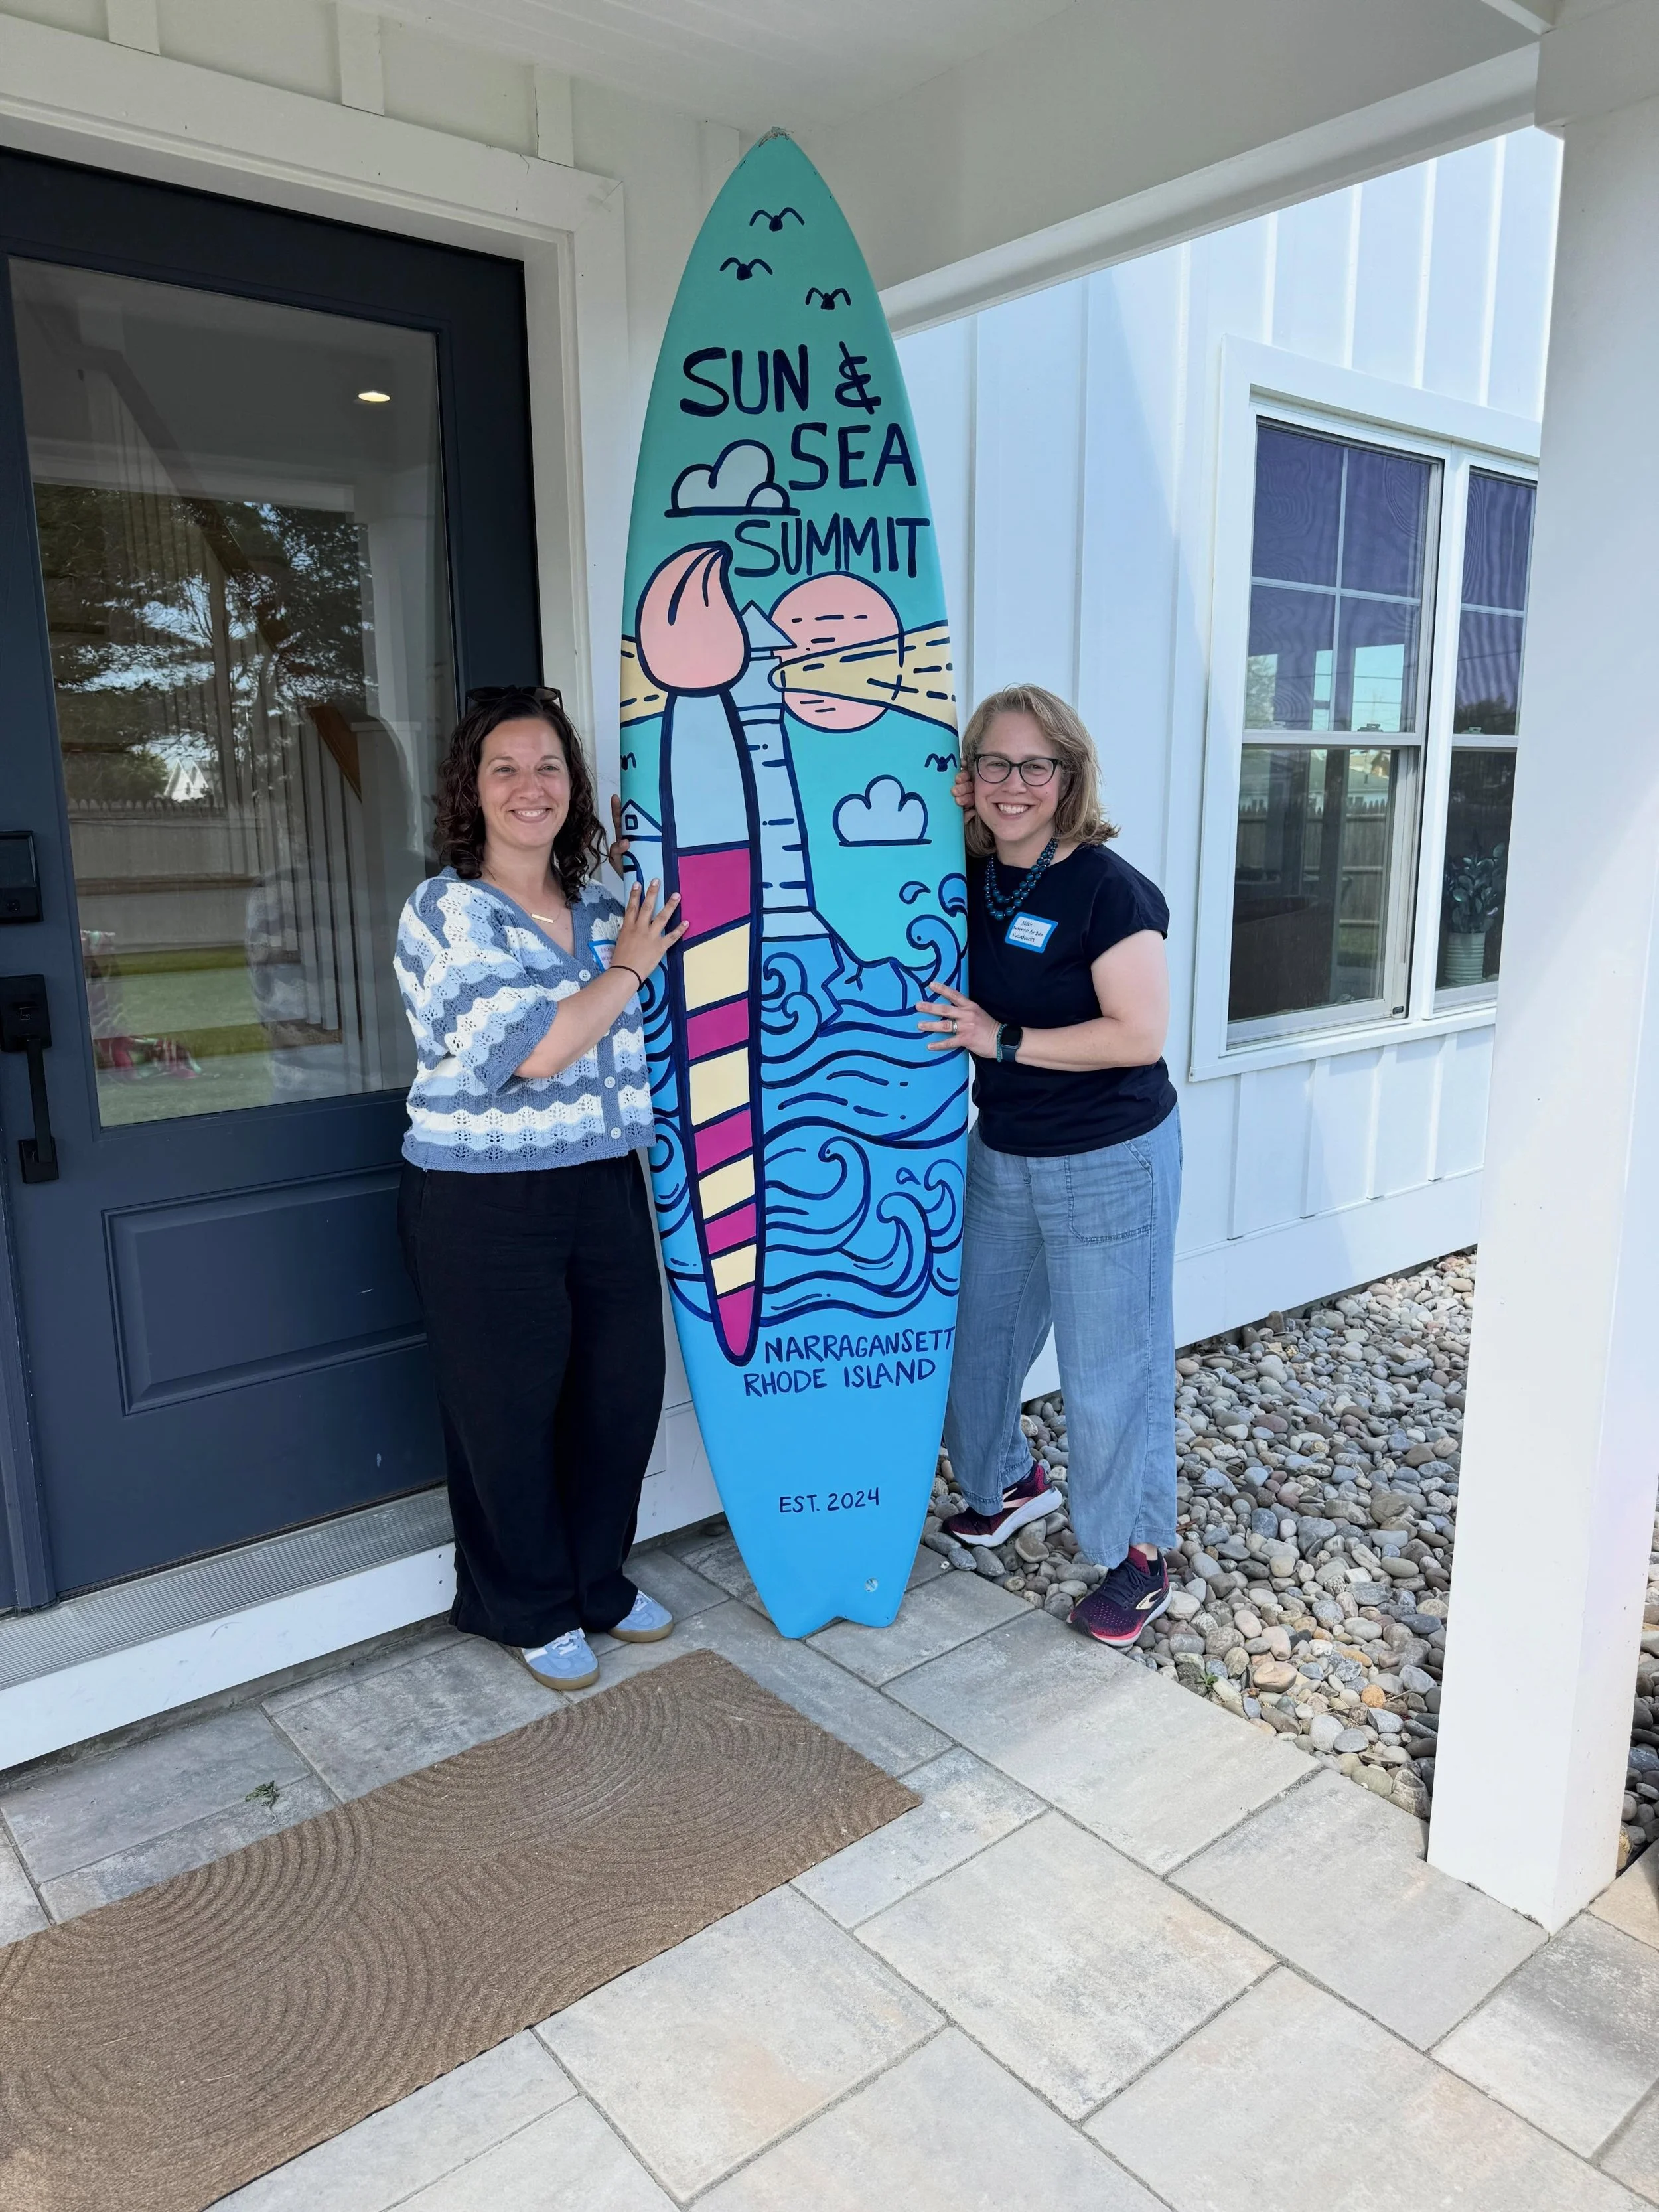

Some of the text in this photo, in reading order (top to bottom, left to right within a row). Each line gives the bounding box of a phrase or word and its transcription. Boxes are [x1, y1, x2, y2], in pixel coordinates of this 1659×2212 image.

[680, 340, 882, 417] SUN &
[788, 421, 917, 491] SEA
[734, 512, 930, 578] SUMMIT
[765, 1326, 956, 1364] NARRAGANSETT
[743, 1358, 936, 1398] RHODE ISLAND
[779, 1487, 880, 1513] EST. 2024
